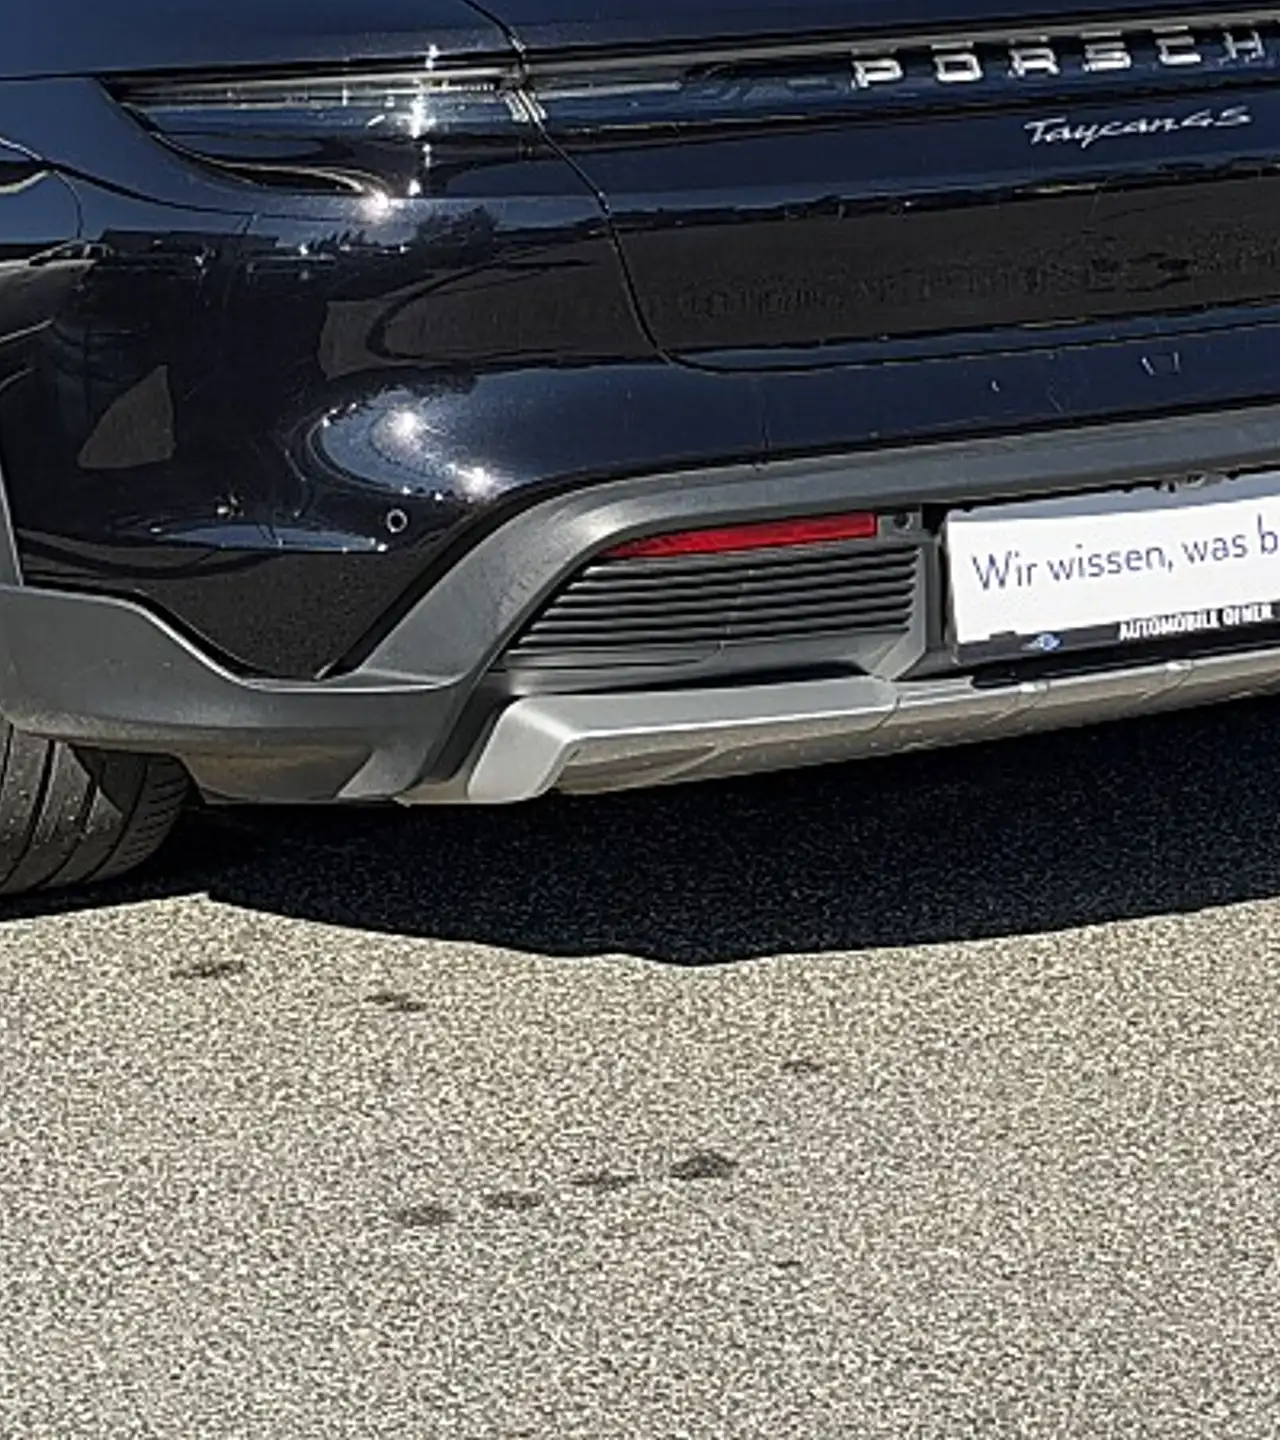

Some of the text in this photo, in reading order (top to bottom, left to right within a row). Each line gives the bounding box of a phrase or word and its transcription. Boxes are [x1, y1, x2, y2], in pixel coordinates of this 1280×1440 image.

[971, 550, 1037, 591] Wir
[1047, 543, 1174, 582] wissen,
[1182, 530, 1249, 564] was
[1119, 610, 1221, 641] AUTOMOBILE
